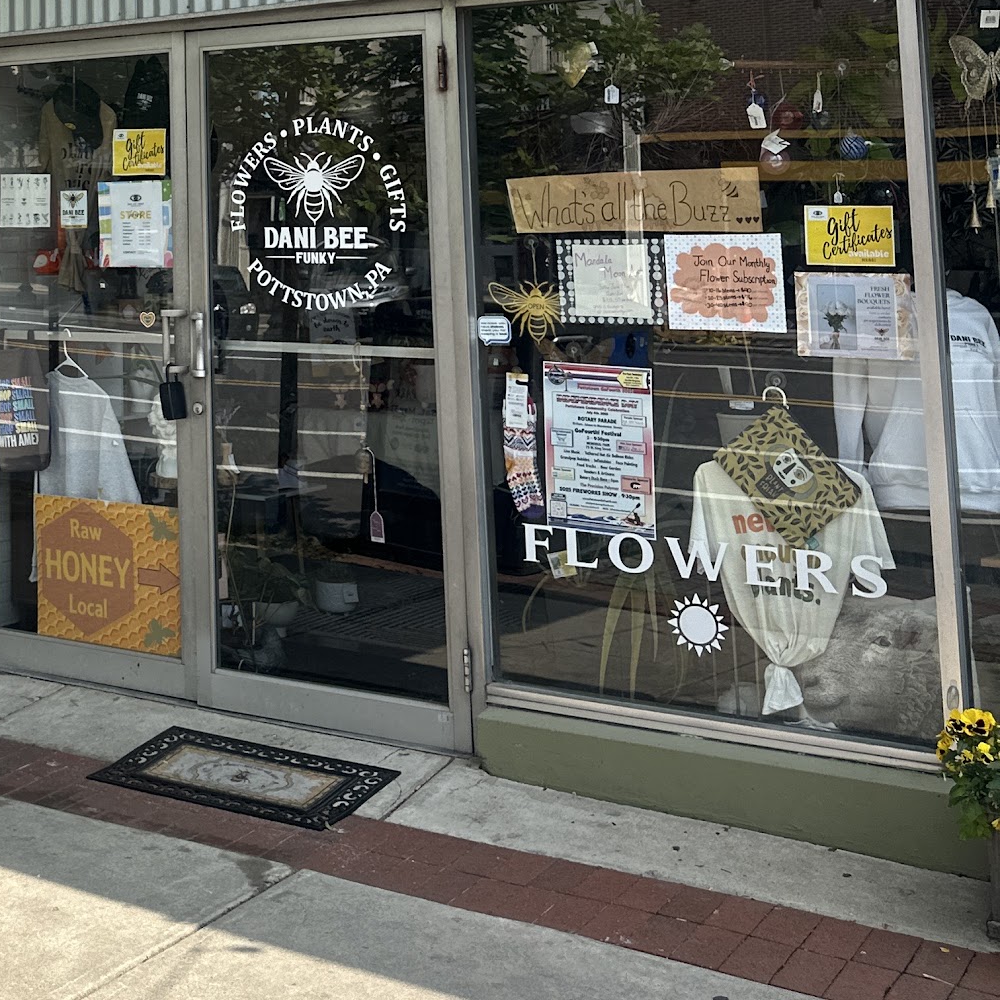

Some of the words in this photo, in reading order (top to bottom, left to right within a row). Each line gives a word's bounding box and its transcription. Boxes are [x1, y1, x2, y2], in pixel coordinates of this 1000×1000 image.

[230, 131, 277, 232] FLOWERS
[291, 116, 374, 152] PLANTS
[379, 163, 406, 233] GIFTS
[601, 182, 626, 228] all
[630, 188, 667, 221] the
[668, 180, 732, 227] Buzz
[264, 226, 317, 249] DANI
[324, 226, 368, 249] BEE
[822, 224, 893, 260] Certificates
[295, 252, 336, 264] FUNKY
[692, 255, 714, 267] Join
[717, 255, 736, 267] Our
[739, 256, 770, 273] Monthly
[848, 249, 889, 258] available
[699, 269, 730, 283] Flower
[601, 429, 622, 437] Festival
[572, 488, 601, 496] FIREWORKS
[70, 518, 102, 542] Raw
[45, 548, 131, 589] HONEY
[522, 522, 888, 599] FLOWERS
[69, 594, 108, 619] Local
